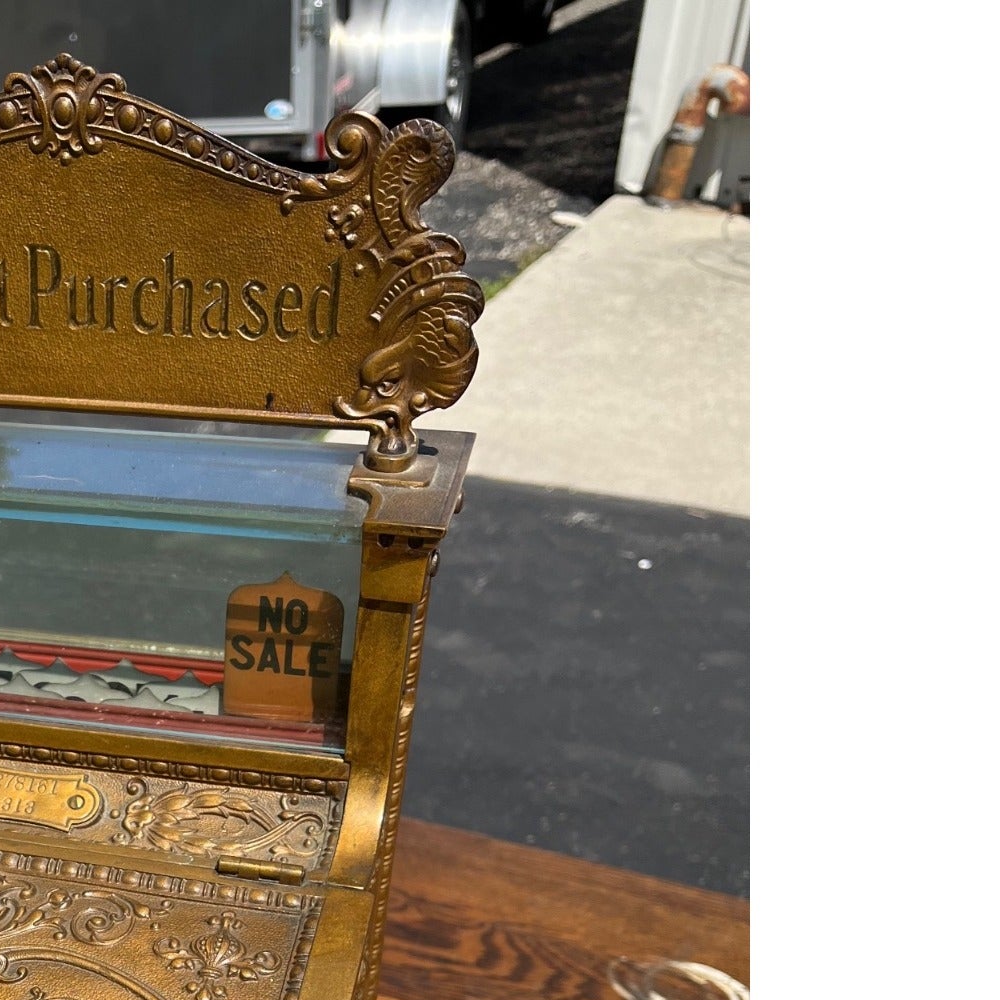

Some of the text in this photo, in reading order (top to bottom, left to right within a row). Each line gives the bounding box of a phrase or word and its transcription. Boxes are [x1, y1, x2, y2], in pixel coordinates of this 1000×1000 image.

[23, 243, 343, 344] Purchased
[258, 595, 309, 636] NO
[229, 634, 334, 678] SALE
[1, 797, 36, 815] 313
